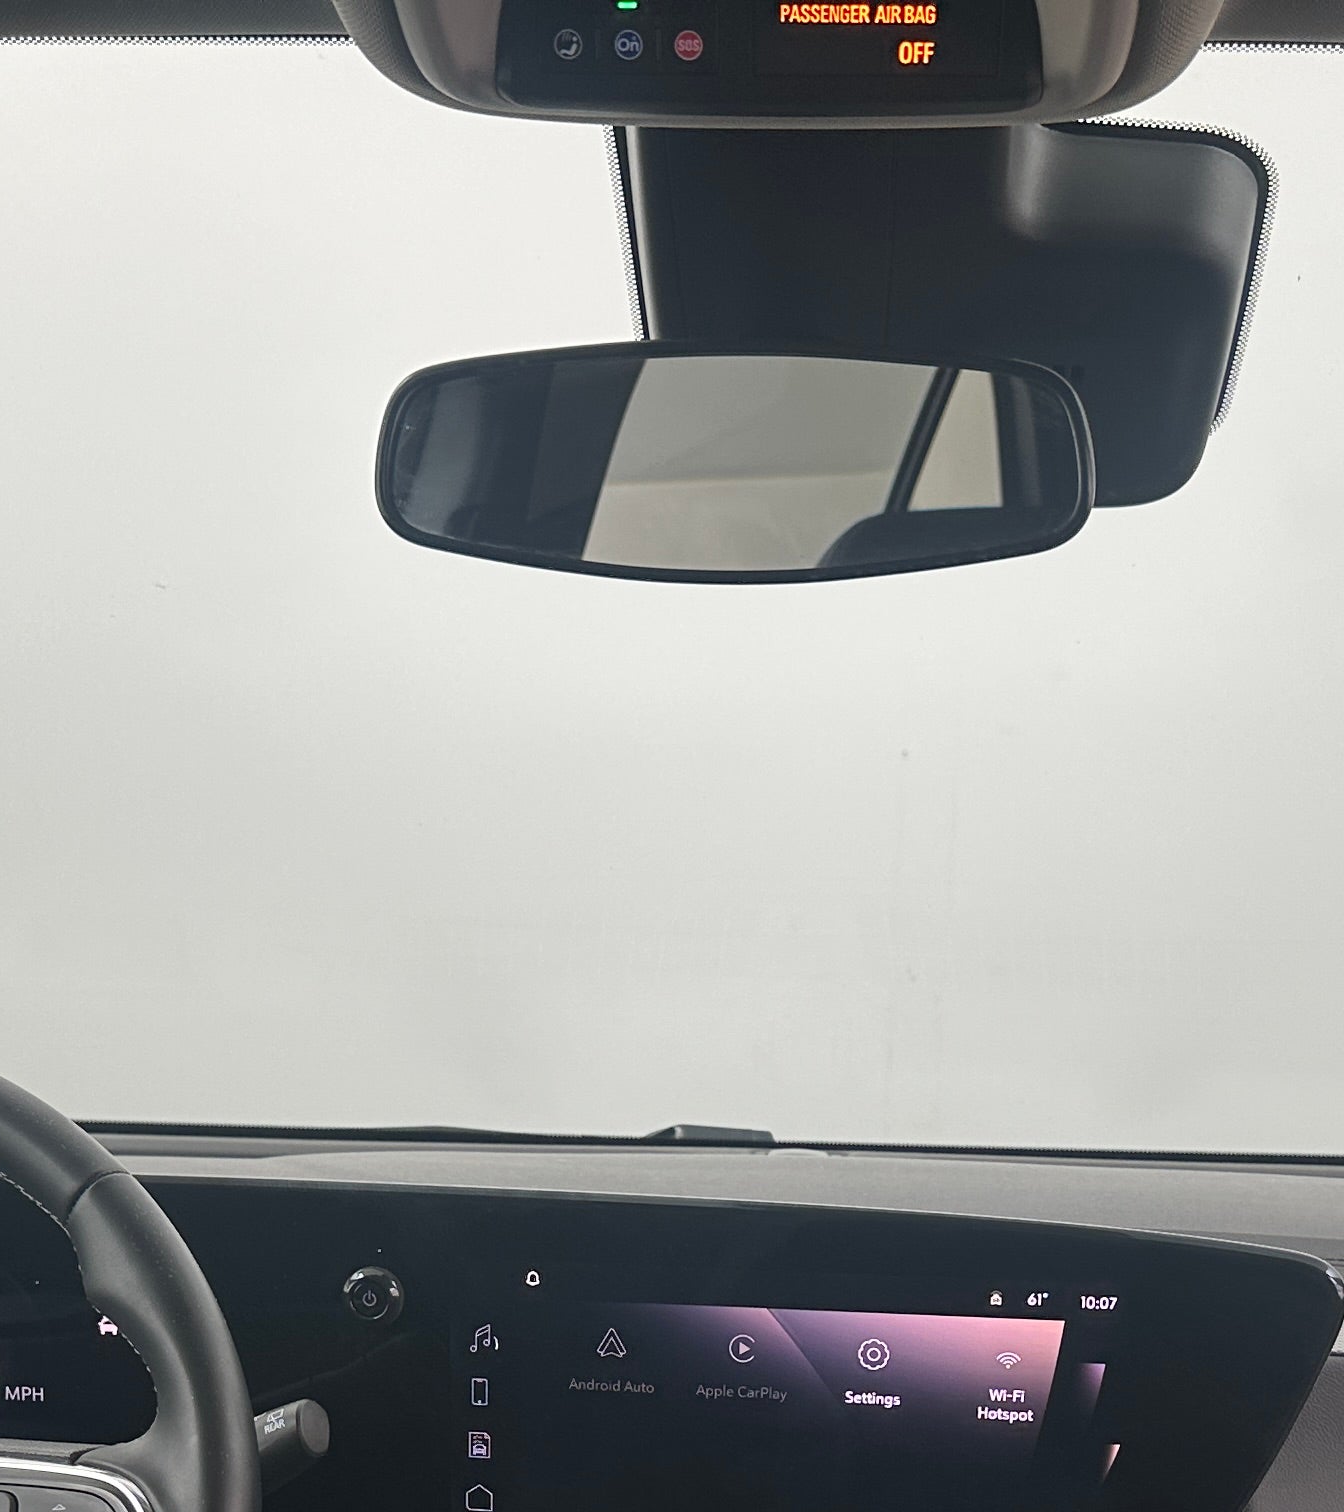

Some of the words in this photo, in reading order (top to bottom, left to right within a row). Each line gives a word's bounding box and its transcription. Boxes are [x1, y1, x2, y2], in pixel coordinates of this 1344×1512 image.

[779, 4, 870, 24] PASSENGER
[874, 5, 902, 24] AIR
[904, 5, 937, 25] BAG
[676, 39, 701, 52] SOS
[898, 41, 935, 65] OFF
[1080, 1295, 1118, 1310] 10:07
[5, 1385, 45, 1402] MPH
[568, 1377, 621, 1392] Android
[624, 1380, 655, 1393] Auto
[695, 1384, 734, 1399] Apple
[737, 1385, 788, 1403] CarPlay
[844, 1391, 901, 1409] Settings
[988, 1388, 1025, 1403] Wi-Fi
[977, 1406, 1034, 1424] Hotspot
